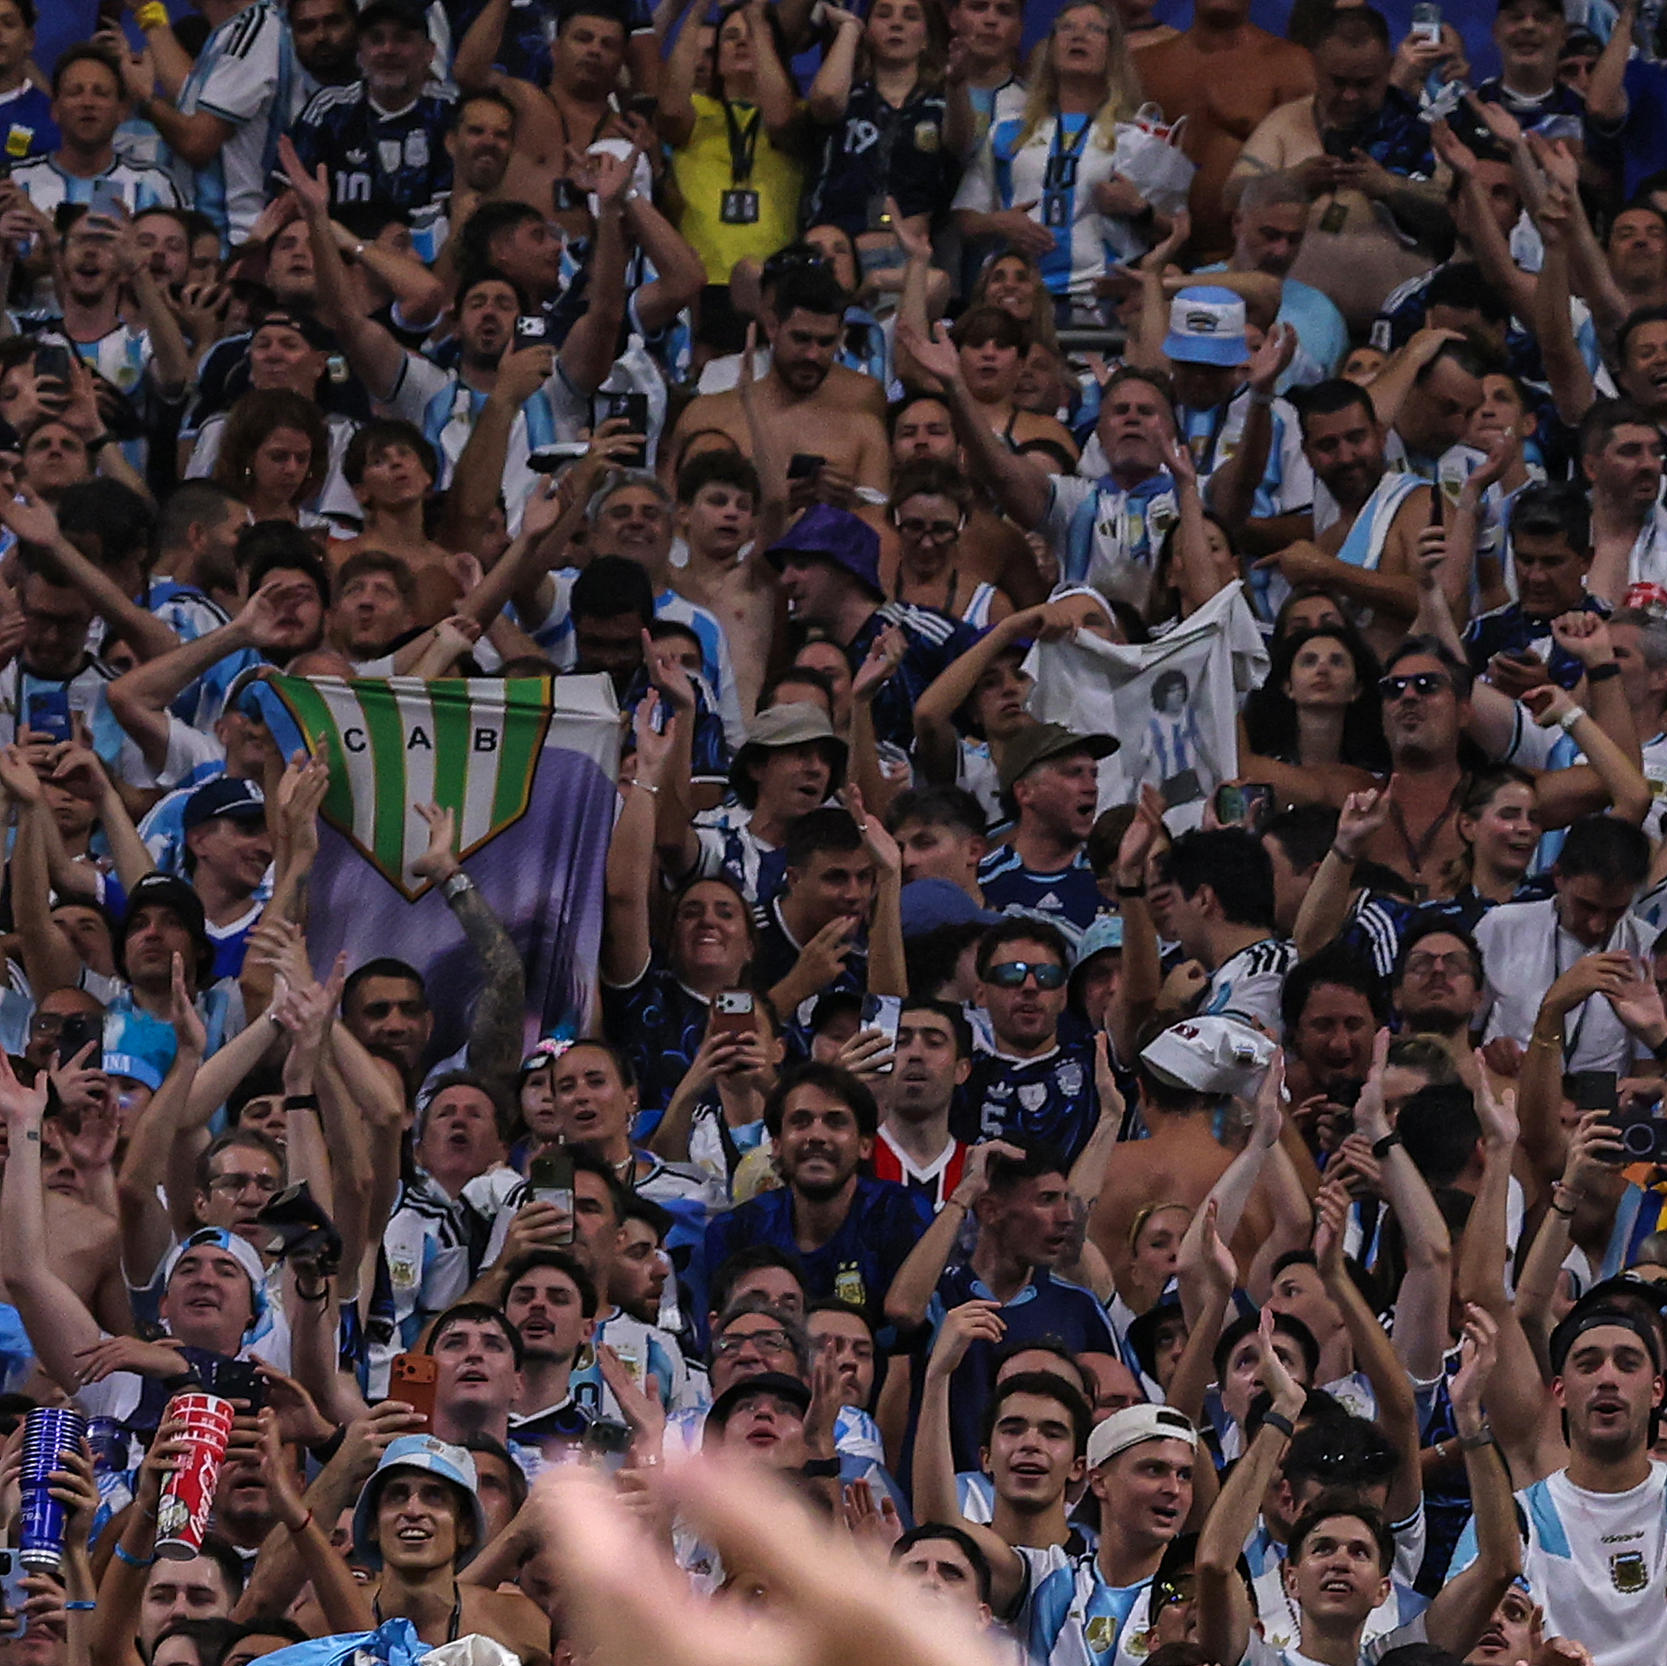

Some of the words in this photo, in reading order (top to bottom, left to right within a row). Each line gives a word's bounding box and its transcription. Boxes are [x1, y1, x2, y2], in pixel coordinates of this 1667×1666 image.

[843, 116, 880, 154] 19
[343, 727, 366, 753] C
[407, 726, 432, 751] A
[474, 728, 497, 753] B
